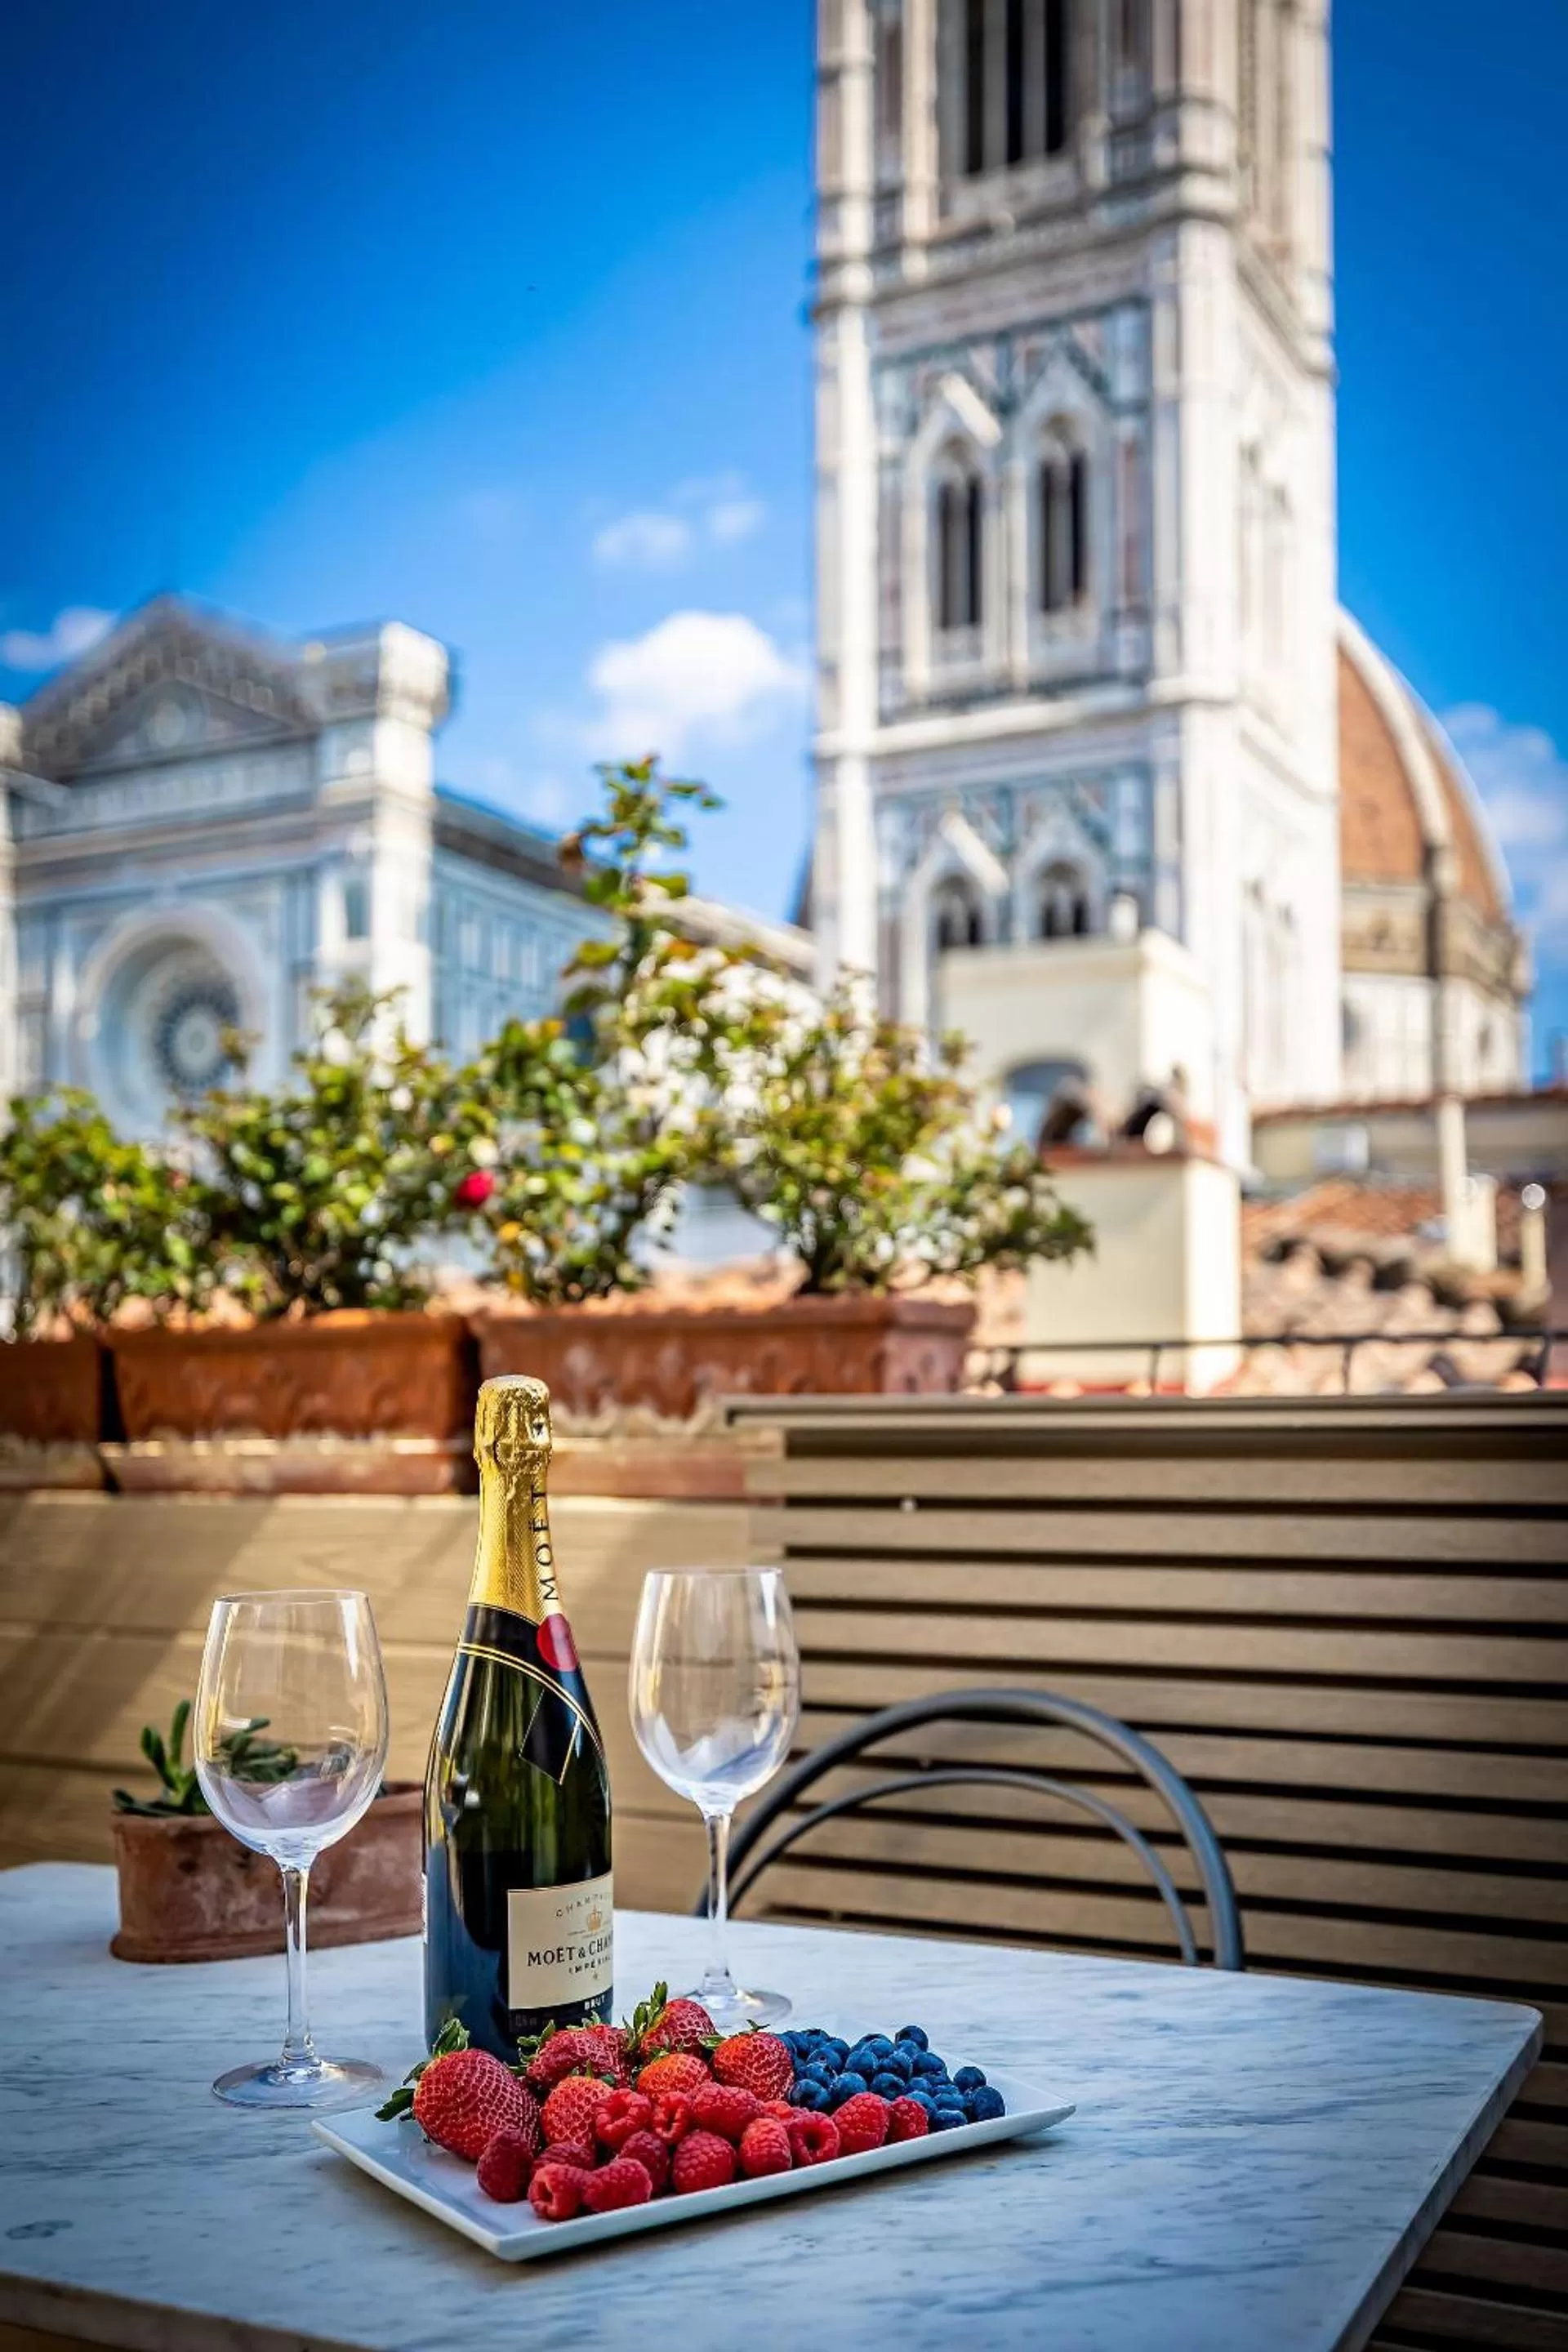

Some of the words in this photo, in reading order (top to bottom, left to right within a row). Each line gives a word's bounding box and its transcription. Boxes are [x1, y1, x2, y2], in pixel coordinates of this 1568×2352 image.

[528, 1484, 559, 1601] MOËT
[578, 1946, 586, 1959] &
[589, 1930, 613, 1956] CHAN
[584, 1993, 605, 2011] BRUT
